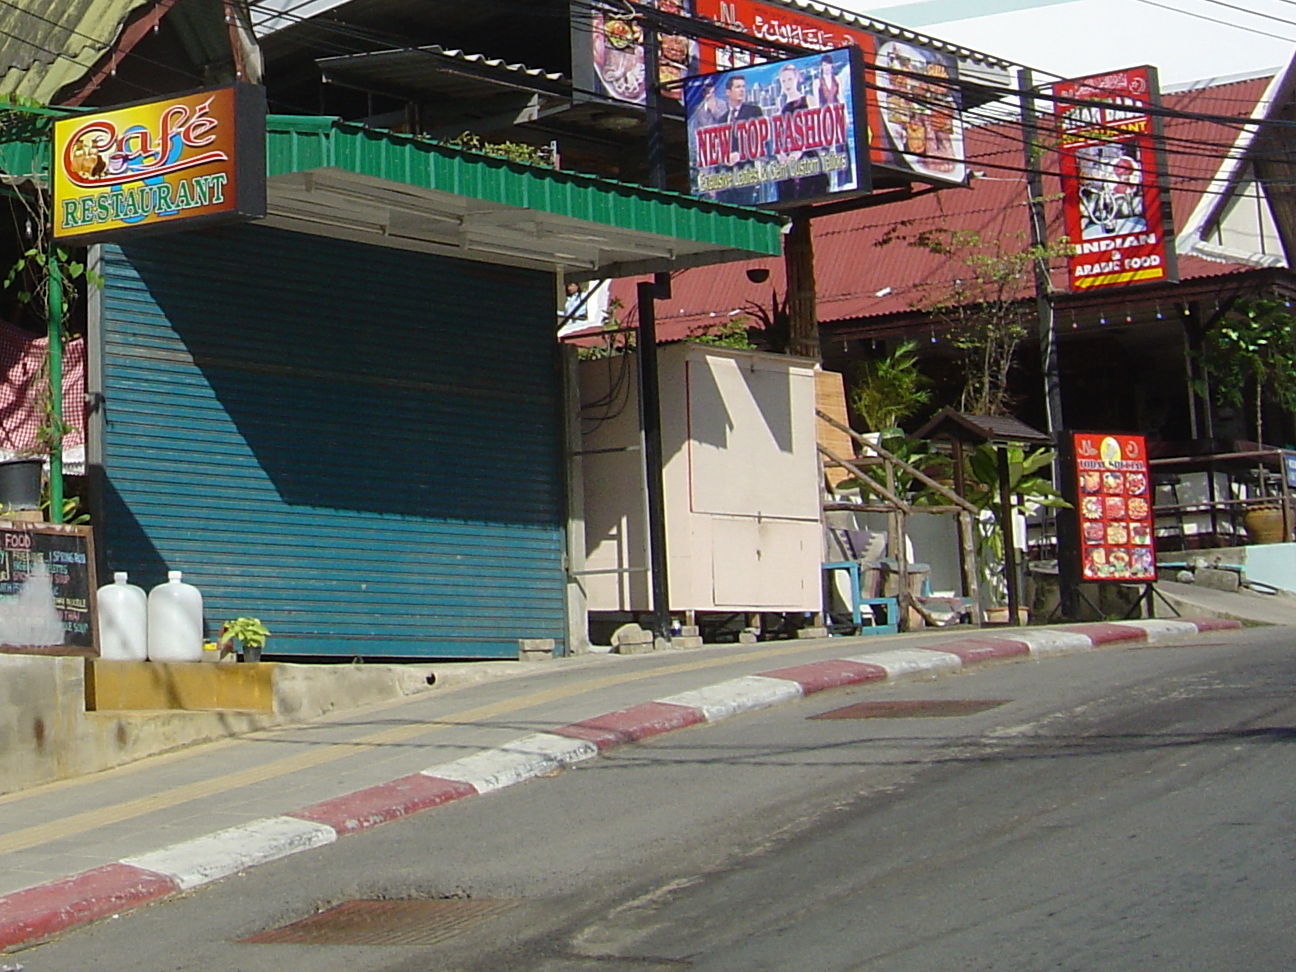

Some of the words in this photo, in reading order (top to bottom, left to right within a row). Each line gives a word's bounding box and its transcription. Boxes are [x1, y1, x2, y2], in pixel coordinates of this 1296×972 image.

[61, 94, 228, 186] Café
[696, 125, 732, 168] NEW
[734, 117, 770, 161] TOP
[771, 102, 847, 155] FASHION
[61, 172, 227, 229] RESTAURANT
[1075, 233, 1156, 255] INDIAN
[1111, 250, 1121, 260] &
[1075, 261, 1121, 277] ARABIC
[1125, 254, 1160, 269] FOOD
[5, 533, 31, 547] FOOD
